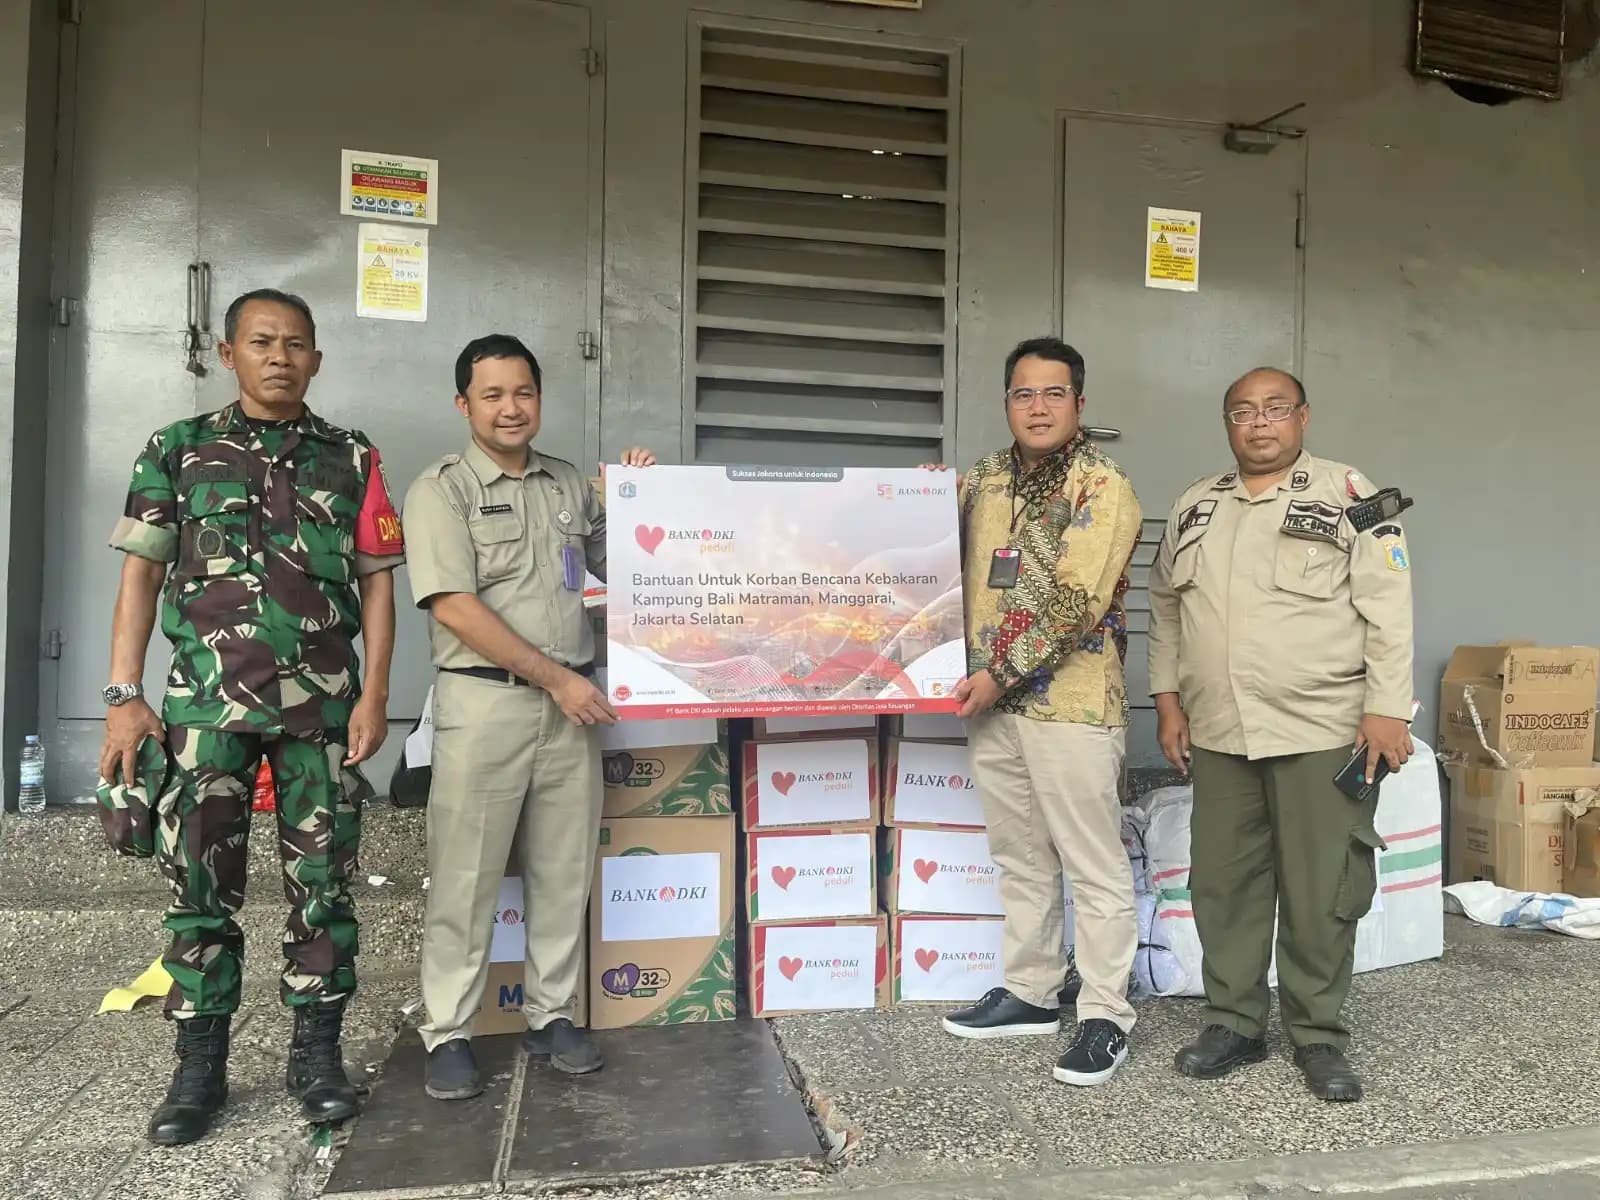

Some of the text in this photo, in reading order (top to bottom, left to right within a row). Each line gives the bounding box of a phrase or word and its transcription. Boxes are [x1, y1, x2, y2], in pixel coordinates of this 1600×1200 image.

[361, 175, 394, 184] DILARANG
[1161, 225, 1187, 233] BAHAYA
[377, 245, 410, 255] BAHAYA
[732, 470, 756, 478] Sukses
[757, 470, 783, 478] Jakarta
[898, 488, 922, 496] BANK
[1287, 517, 1335, 536] TRC-BPBD
[668, 530, 736, 540] BANK DKI
[700, 542, 735, 554] peduli
[632, 572, 938, 586] Bantuan Untuk Korban Bencana Kebakaran
[632, 591, 896, 608] Kampung Bali Matraman, Manggarai,
[632, 612, 744, 626] Jakarta Selatan
[755, 706, 784, 714] keuangan
[888, 704, 916, 712] Keuangan
[1505, 710, 1589, 730] INDOCAFÉ
[1508, 730, 1587, 752] Coffeemix
[608, 761, 622, 776] M
[635, 762, 653, 775] 32
[798, 771, 852, 783] BANK DKI
[903, 773, 947, 788] BANK
[824, 781, 853, 792] peduli
[1543, 792, 1570, 800] JANGAN
[798, 866, 853, 876] BANK DKI
[940, 864, 994, 875] BANK DKI
[824, 876, 854, 887] peduli
[965, 875, 994, 885] peduli
[610, 886, 707, 902] BANK DKI
[941, 952, 995, 961] BANK DKI
[805, 959, 859, 968] BANK DKI
[966, 961, 995, 972] peduli
[613, 972, 629, 987] M
[641, 972, 659, 985] 32
[830, 969, 859, 979] peduli
[498, 983, 524, 1007] M
